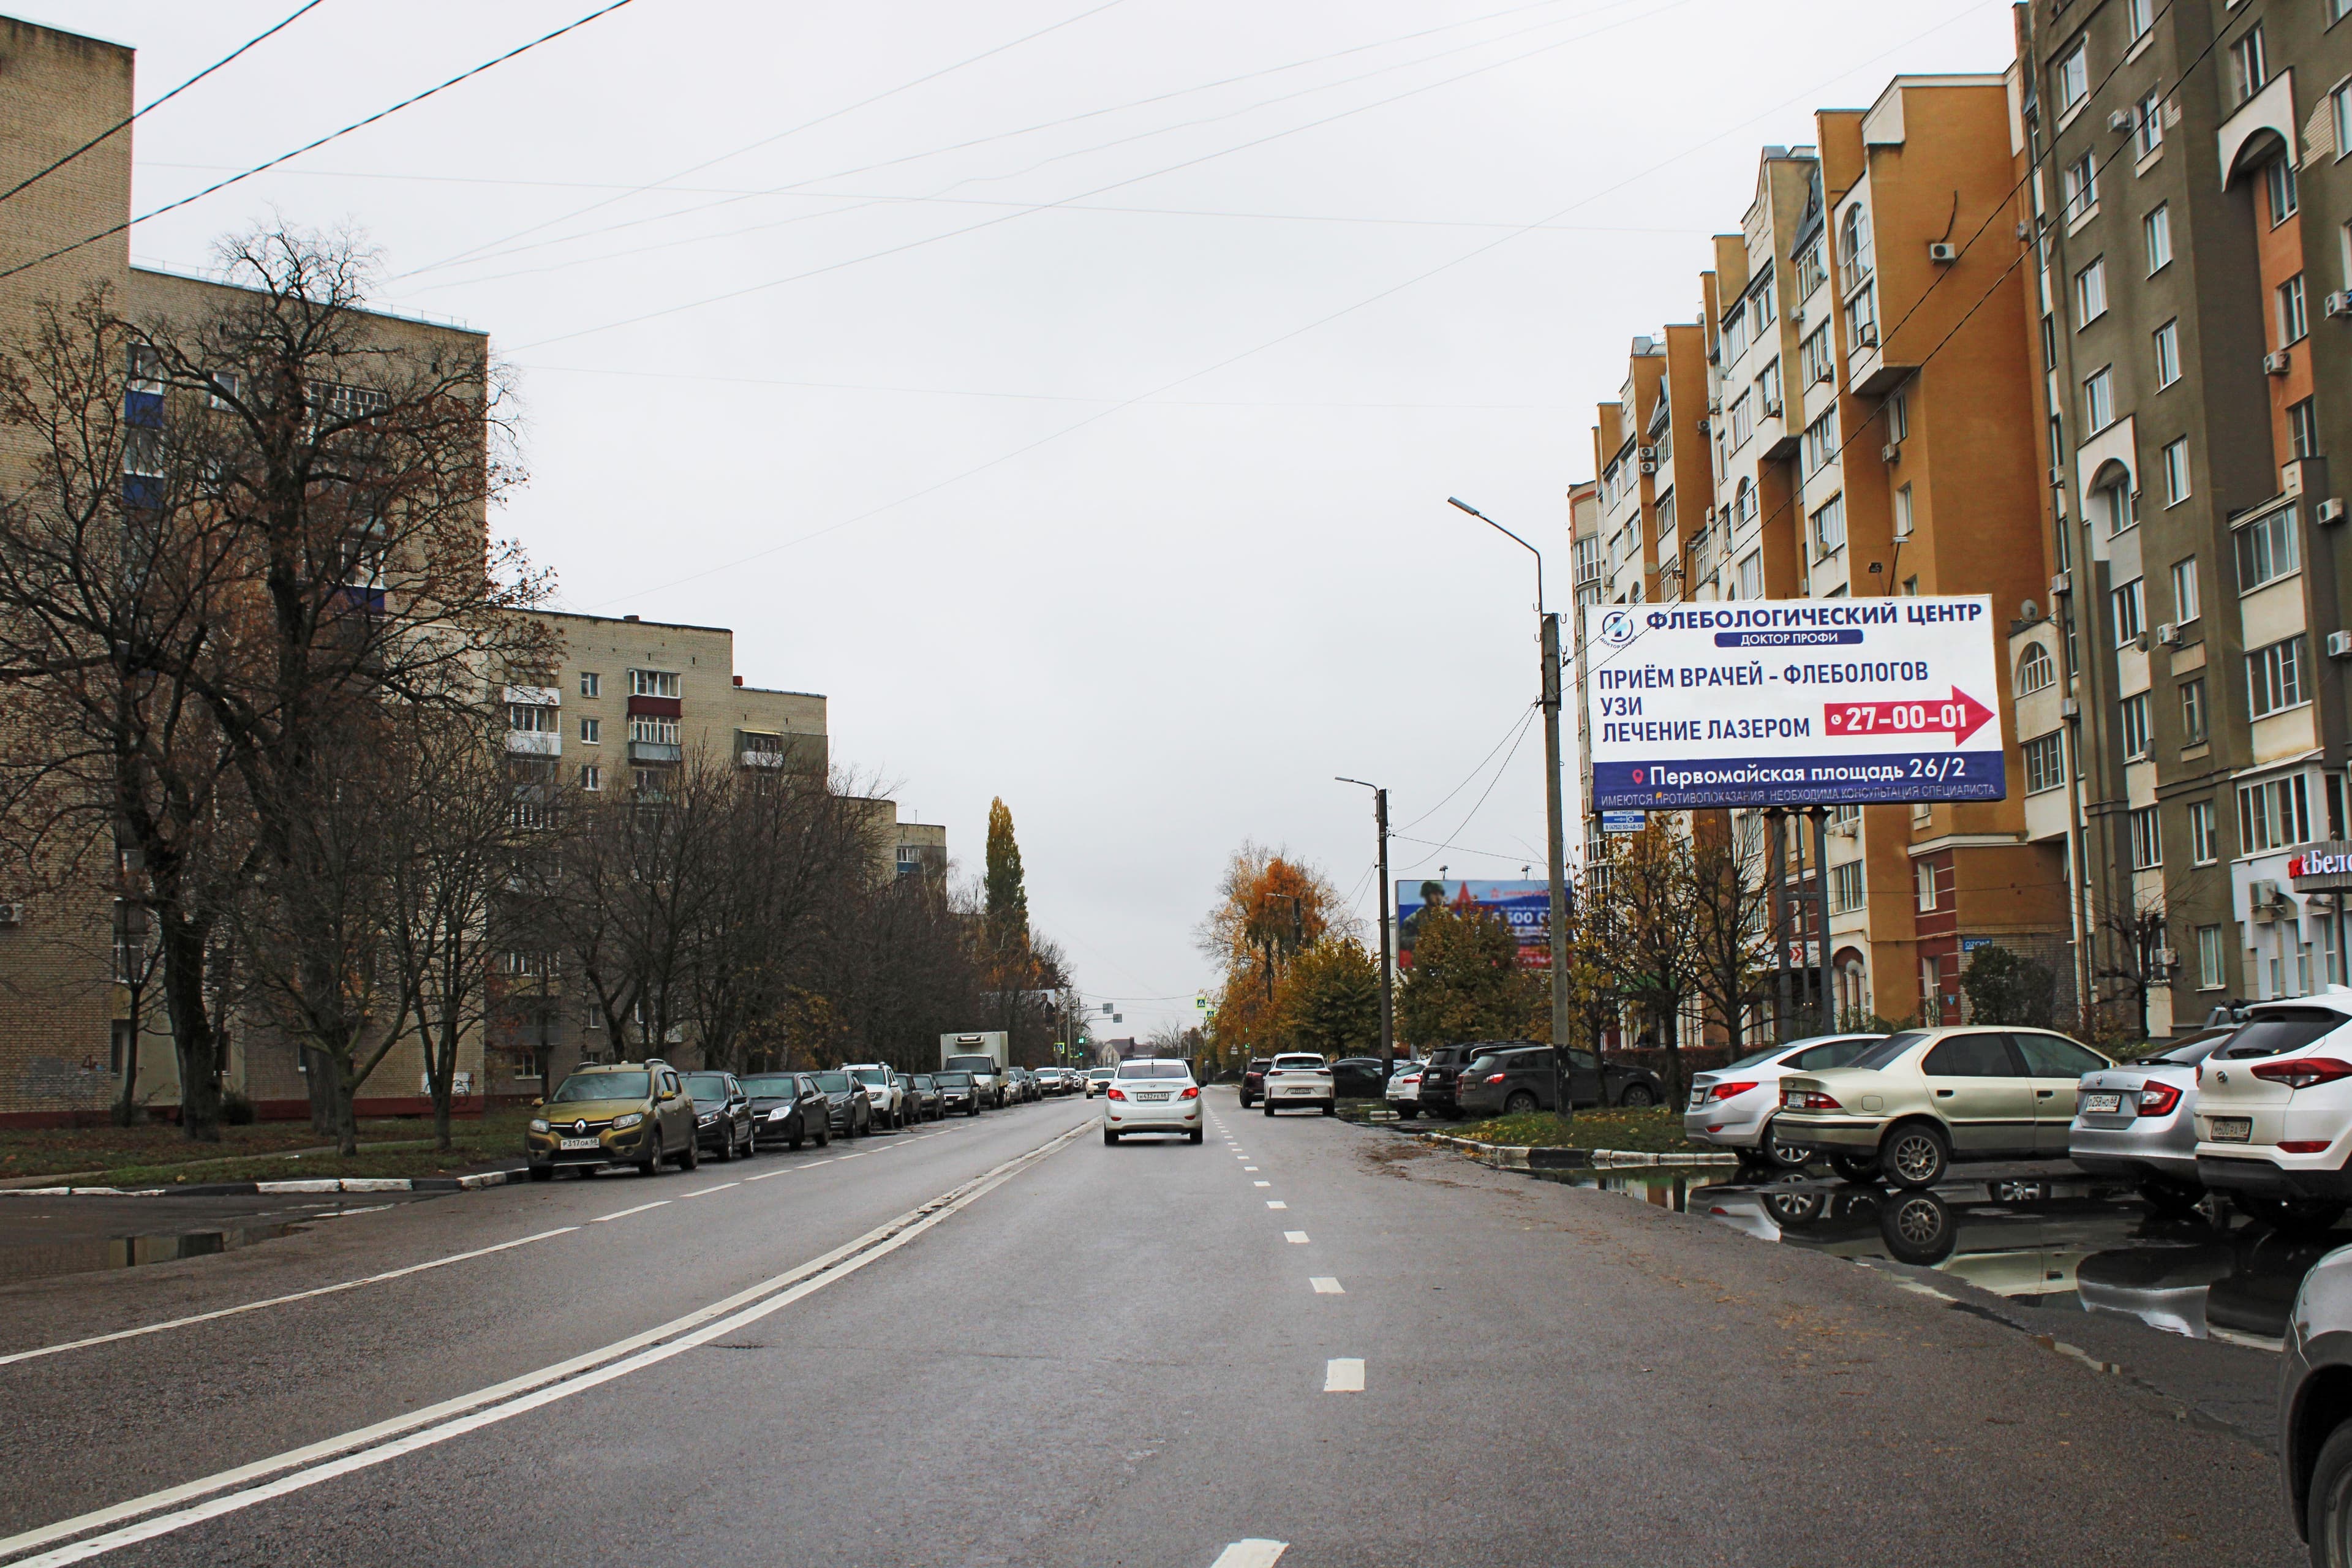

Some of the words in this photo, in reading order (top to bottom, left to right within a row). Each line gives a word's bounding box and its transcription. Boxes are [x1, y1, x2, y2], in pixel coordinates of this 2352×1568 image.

[1646, 602, 1897, 630] ФЛЕБОЛОГИЧЕСКИЙ
[1907, 604, 1981, 625] ЦЕНТР
[1741, 633, 1789, 646] ДОКТОР
[1793, 632, 1838, 644] ПРОФИ
[1600, 665, 1674, 689] ПРИЁМ
[1681, 661, 1763, 687] ВРАЧЕЙ
[1784, 662, 1928, 684] ФЛЕБОЛОГОВ
[1600, 697, 1642, 717] УЗИ
[1846, 704, 1967, 731] 27-00-01
[1603, 721, 1702, 742] ЛЕЧЕНИЕ
[1708, 718, 1810, 740] ЛАЗЕРОМ
[1651, 764, 1804, 789] Первомайская
[1811, 766, 1904, 782] площадь
[1909, 758, 1966, 782] 26/2
[1601, 794, 1653, 807] ИМЕЮТСЯ
[1770, 788, 1838, 802] НЕОБХОДИМА
[1842, 785, 1918, 800] КОНСУЛЬТАЦИЯ
